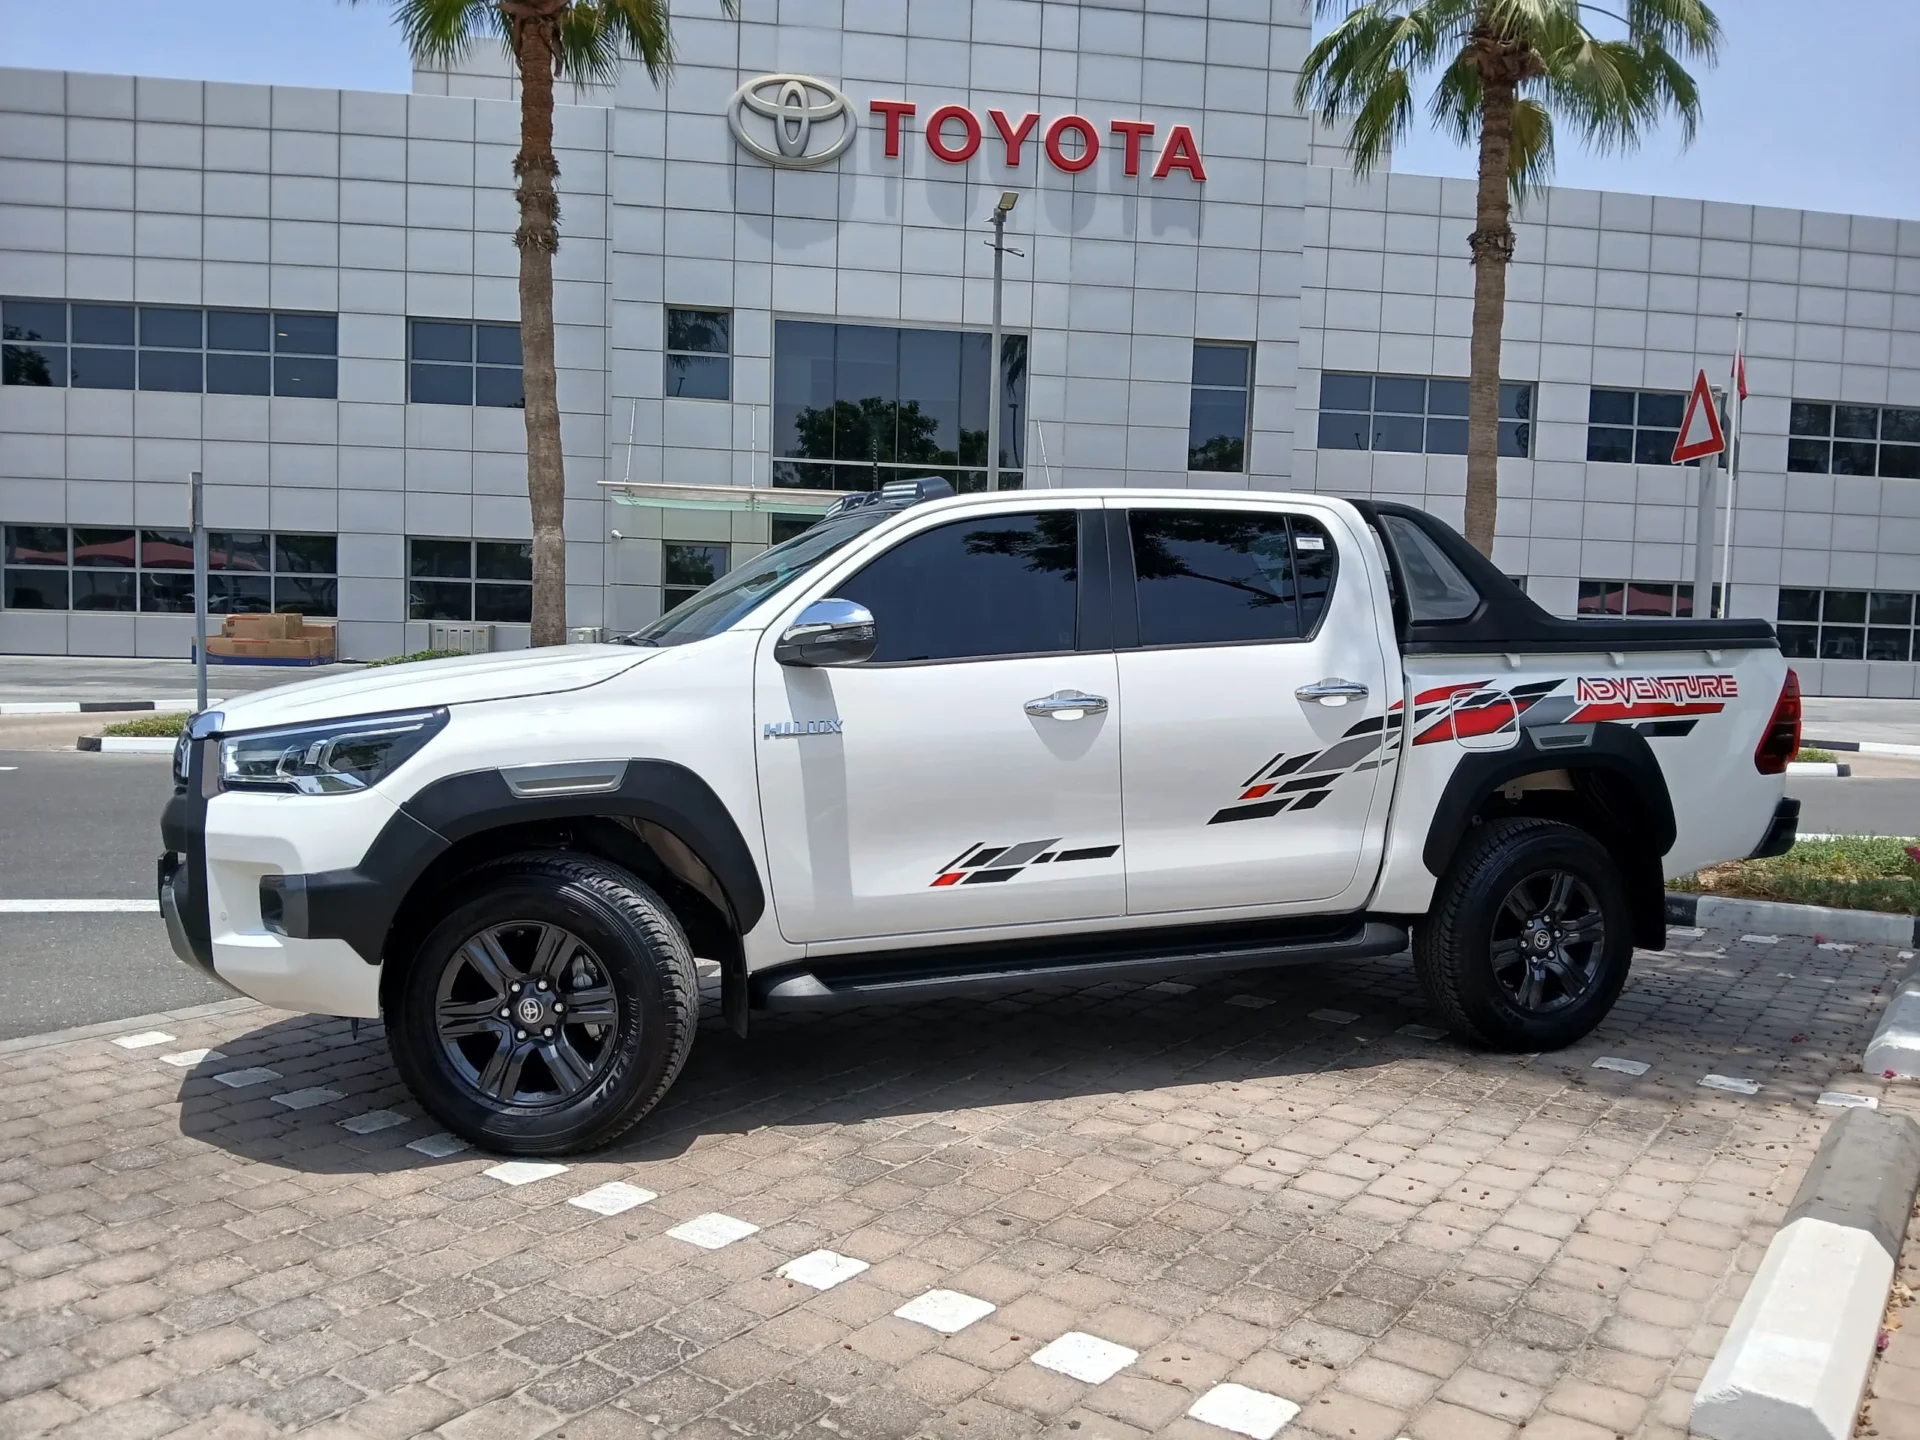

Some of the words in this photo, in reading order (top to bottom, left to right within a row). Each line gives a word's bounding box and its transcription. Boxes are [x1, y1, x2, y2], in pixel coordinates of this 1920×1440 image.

[869, 99, 1207, 182] TOYOTA
[1576, 674, 1738, 706] ADVENTURE
[764, 720, 843, 737] HILUX
